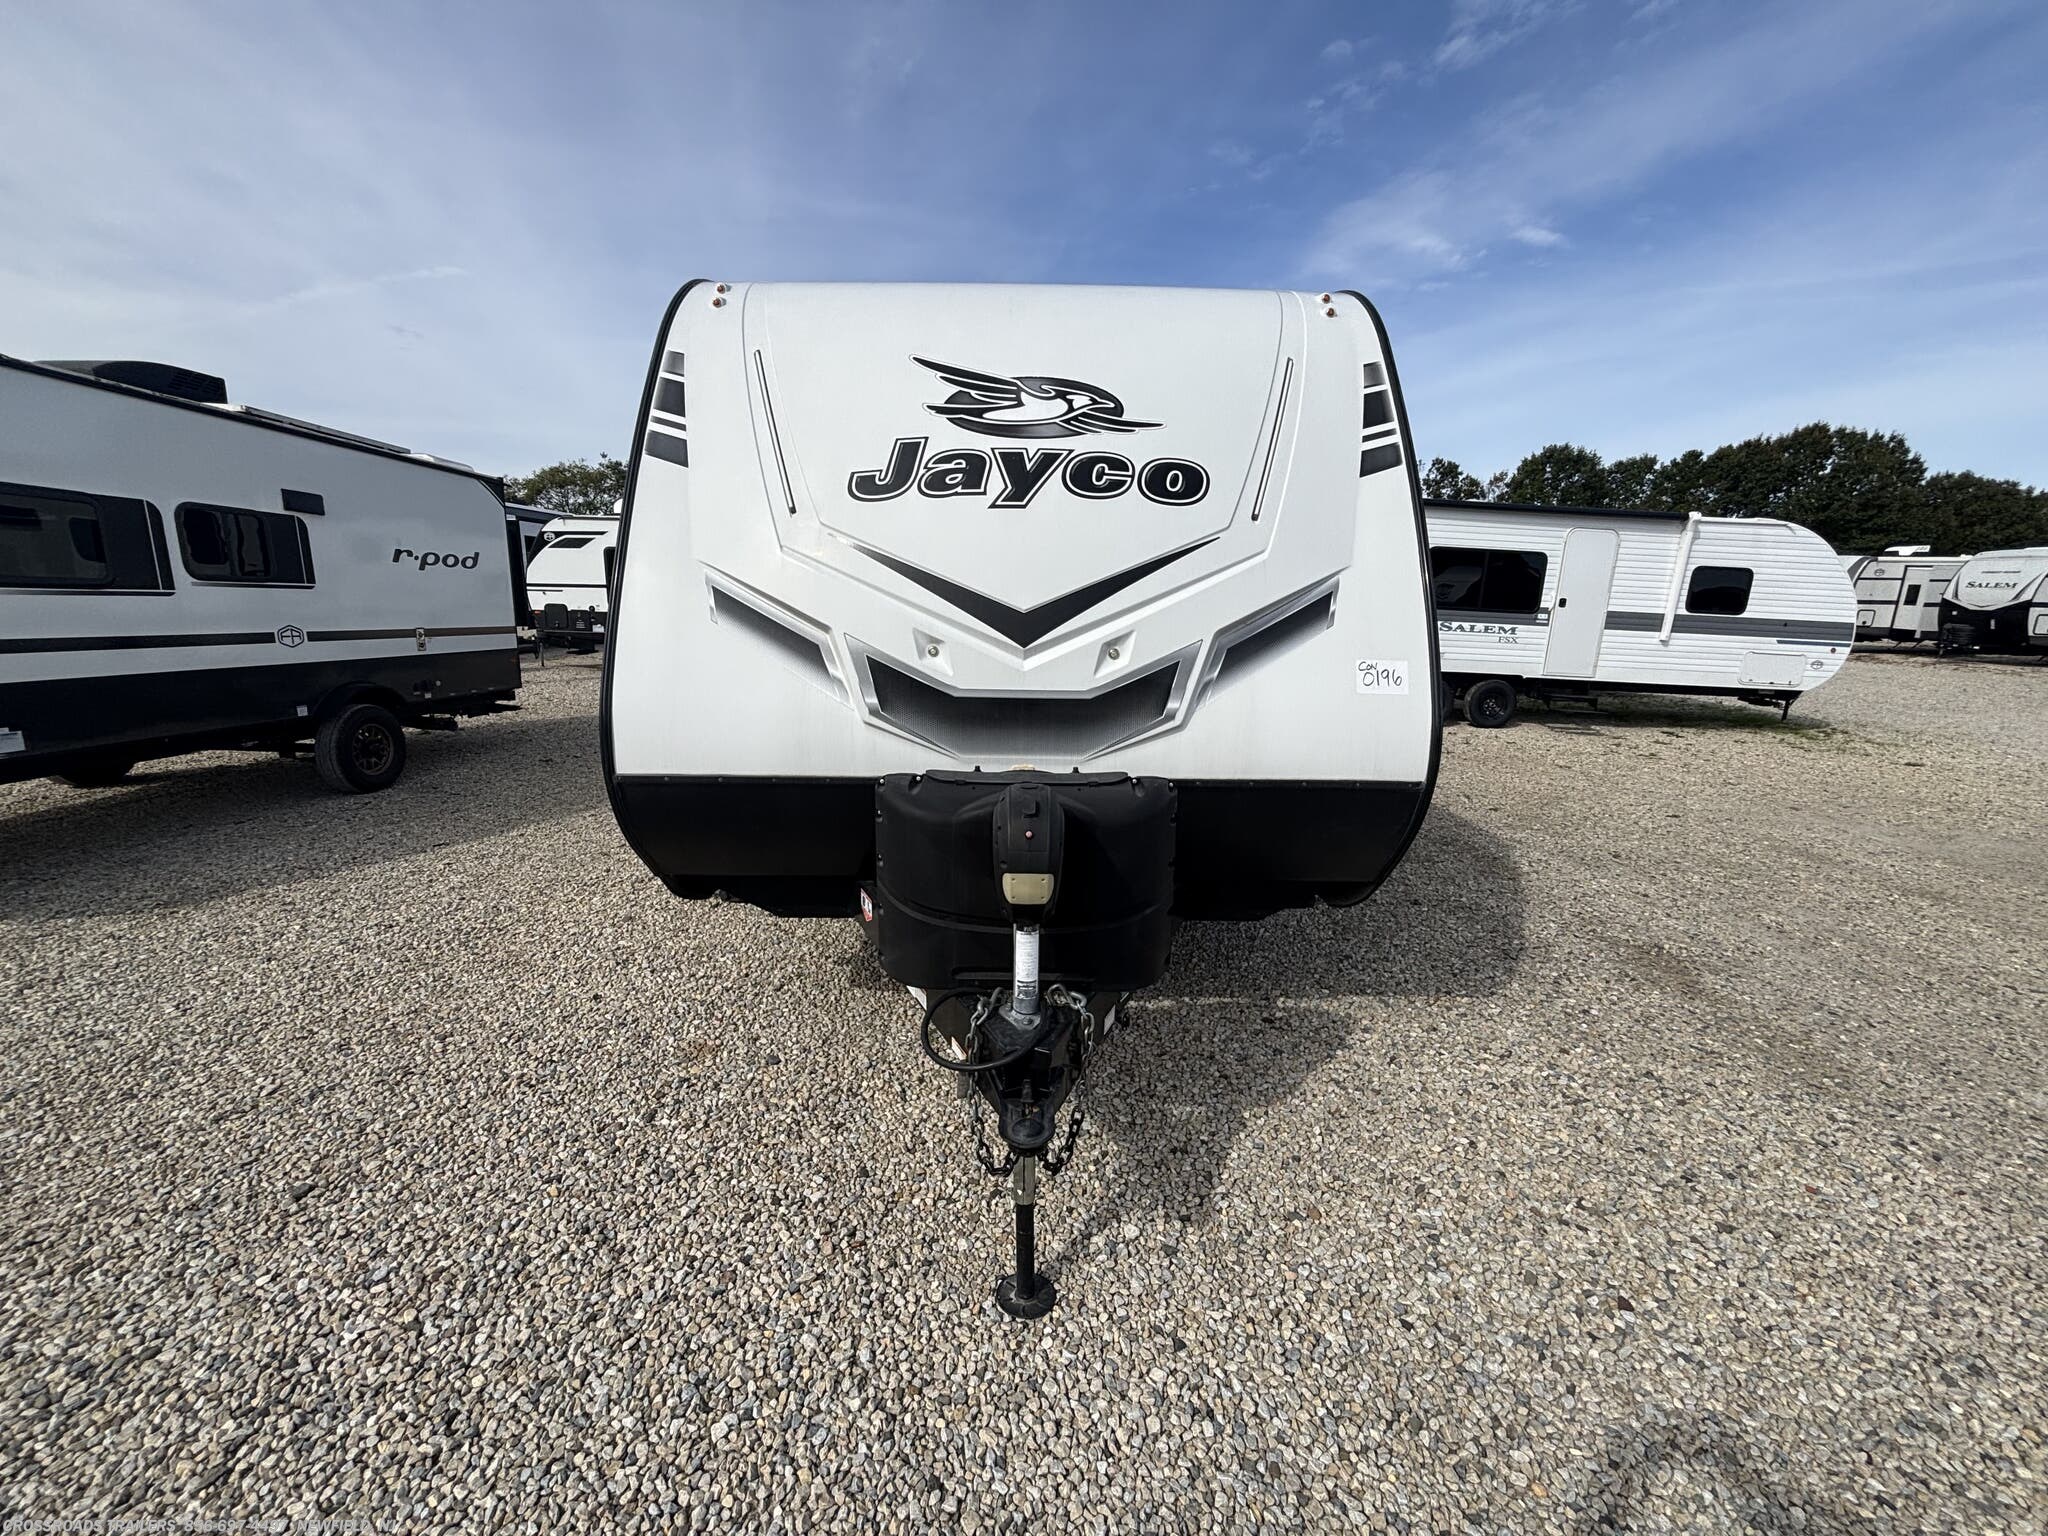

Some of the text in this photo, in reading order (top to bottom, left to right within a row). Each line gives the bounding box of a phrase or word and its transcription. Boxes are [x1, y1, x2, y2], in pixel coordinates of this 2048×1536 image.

[847, 436, 1211, 509] Jayco
[1965, 581, 2018, 589] SALEM
[1439, 621, 1519, 635] SALEM
[1498, 636, 1519, 644] FSX
[1363, 669, 1402, 687] 0196
